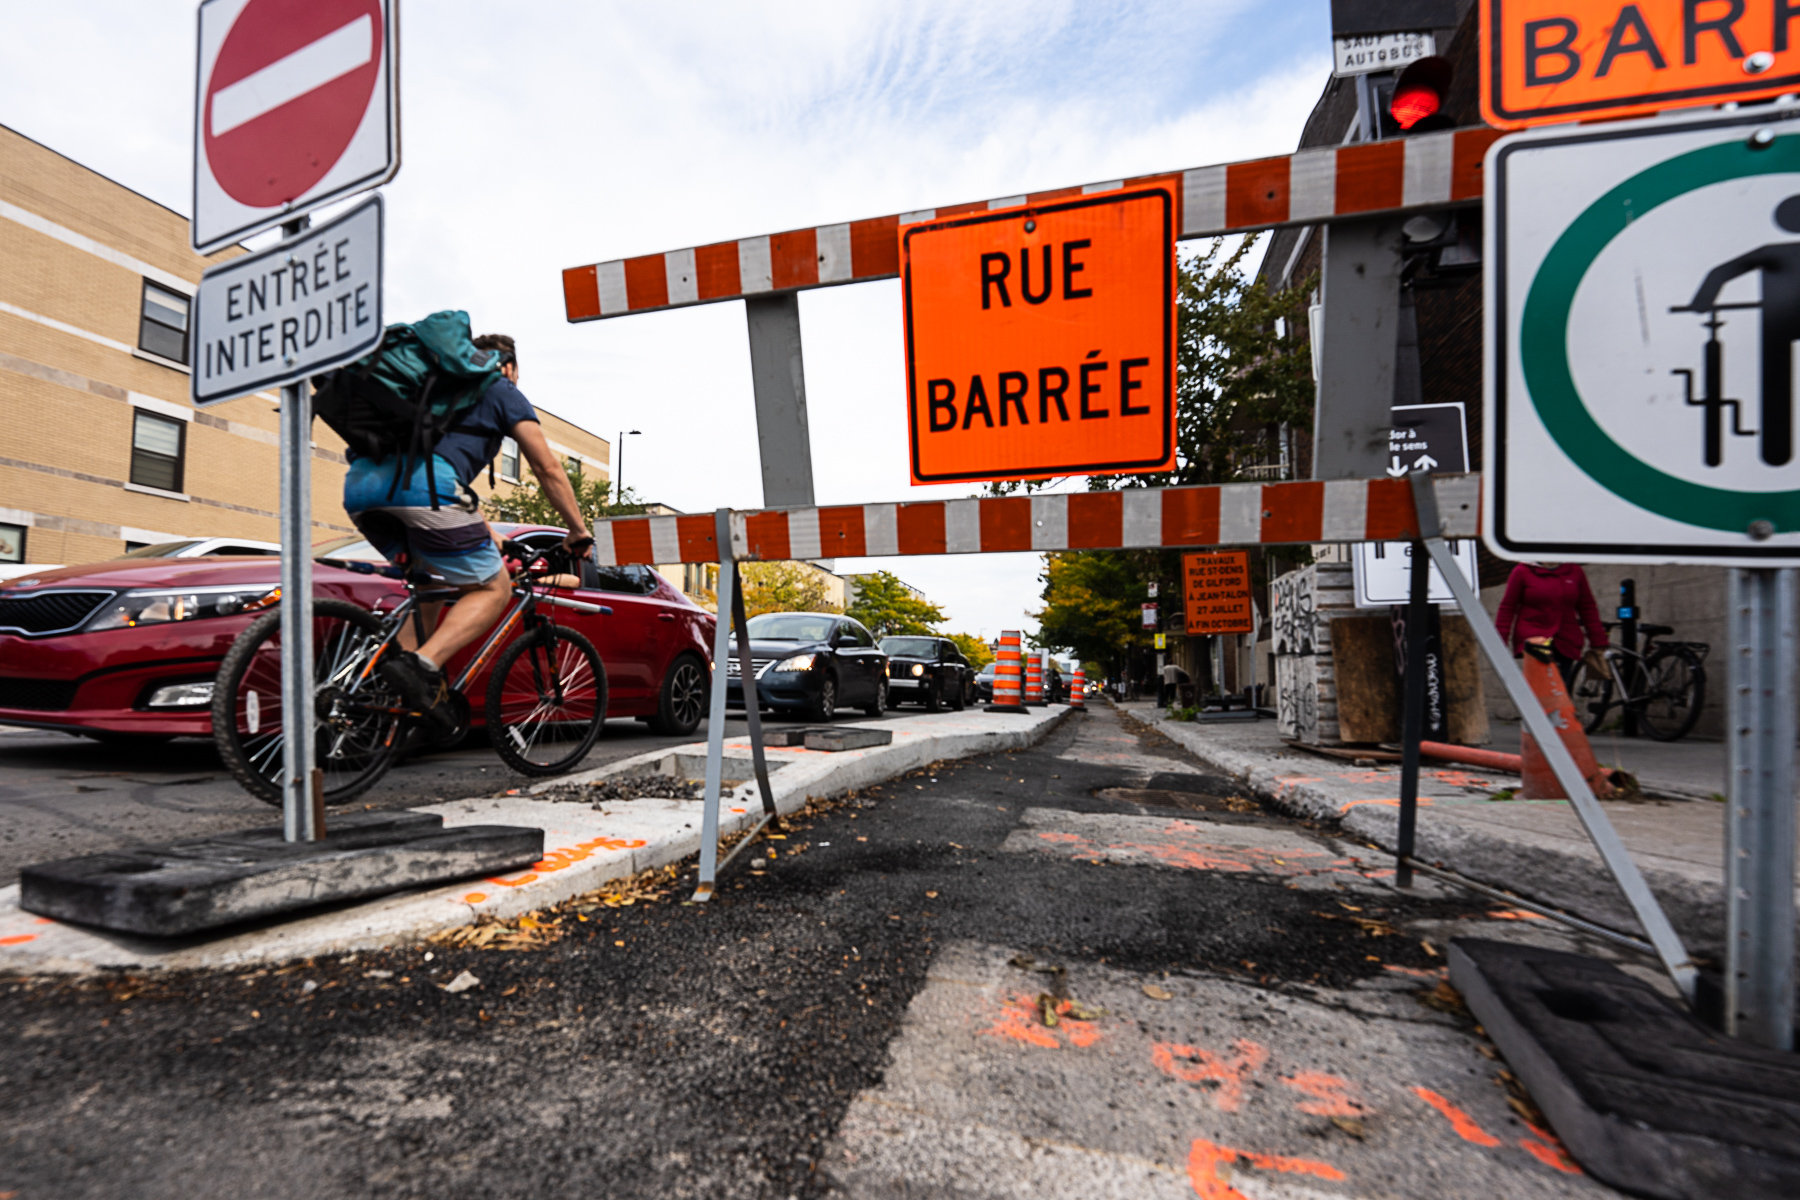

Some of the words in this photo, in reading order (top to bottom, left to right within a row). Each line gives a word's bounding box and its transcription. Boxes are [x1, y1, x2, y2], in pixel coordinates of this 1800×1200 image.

[1345, 43, 1423, 67] AUTOBUS
[228, 237, 350, 322] ENTRÉE
[980, 238, 1093, 310] RUE
[206, 282, 369, 379] INTERDITE
[927, 349, 1150, 433] BARRÉE
[1196, 556, 1235, 566] TRAVAUX
[1189, 567, 1206, 576] RUE
[1207, 565, 1244, 576] ST-DENIS
[1193, 579, 1204, 588] DE
[1206, 577, 1241, 587] GILFORD
[1196, 590, 1249, 601] JEAN-TALON
[1197, 605, 1208, 615] 27
[1210, 604, 1243, 614] JUILLET
[1196, 620, 1210, 629] FIN
[1211, 618, 1249, 628] OCTOBRE
